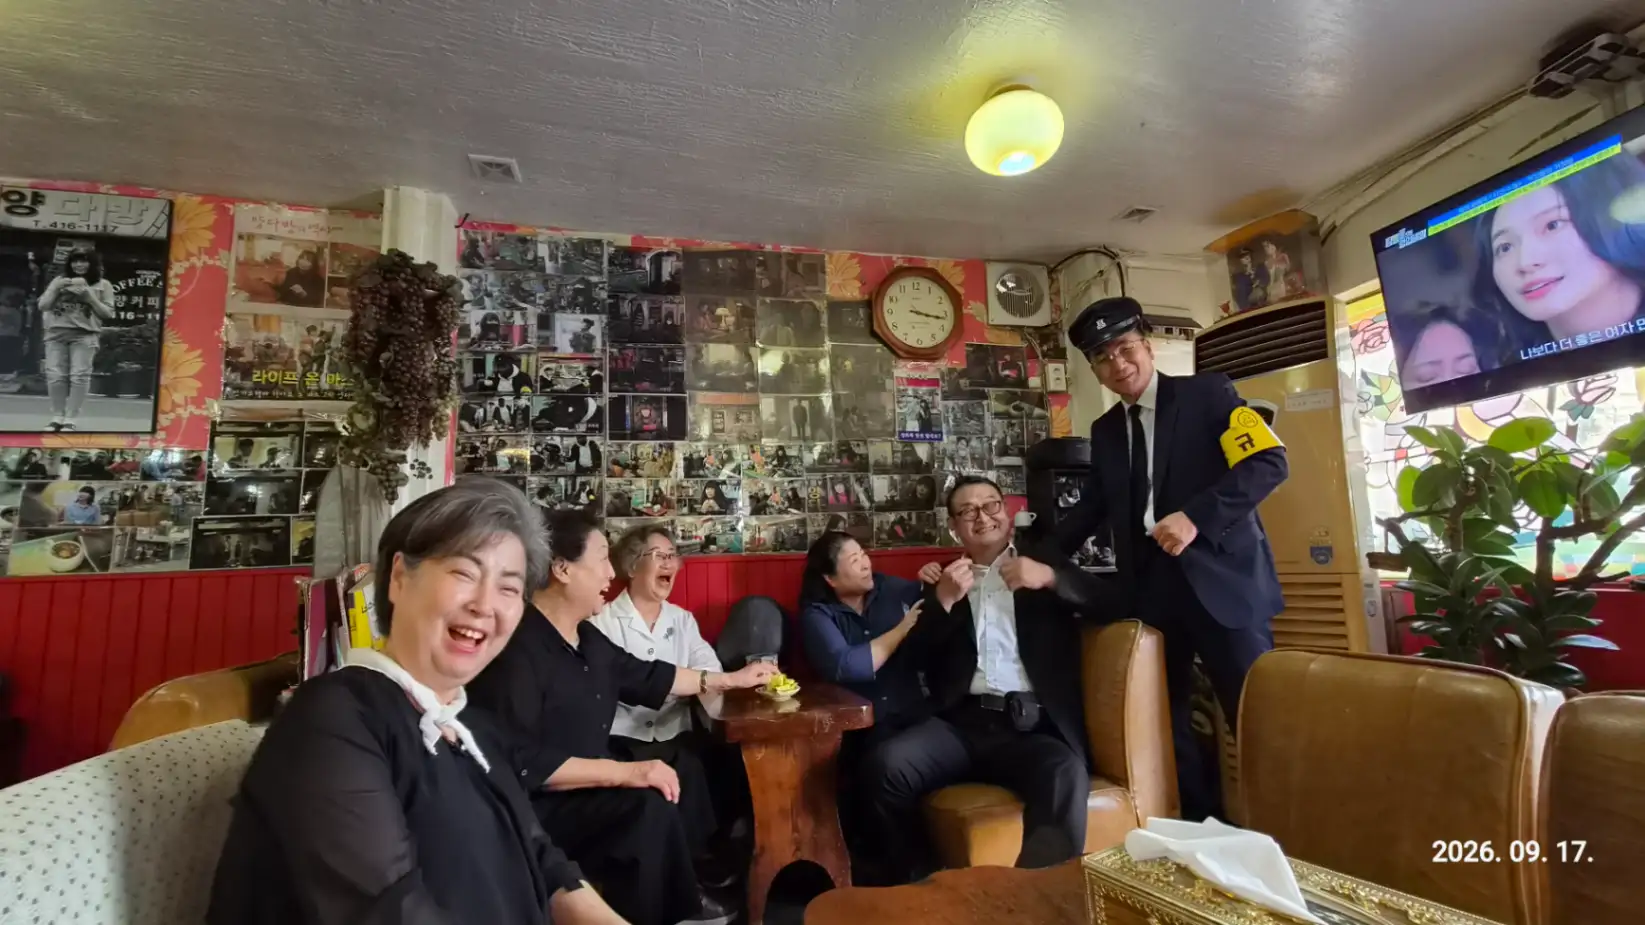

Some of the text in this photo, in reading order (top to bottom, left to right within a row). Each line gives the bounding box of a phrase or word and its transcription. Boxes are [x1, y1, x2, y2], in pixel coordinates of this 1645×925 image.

[112, 277, 154, 294] OFFEE
[899, 284, 906, 294] 11
[912, 282, 920, 291] 12
[928, 283, 933, 294] 1
[888, 295, 898, 304] 10
[937, 296, 943, 304] 2
[891, 321, 898, 331] 8
[938, 324, 945, 332] 4
[902, 332, 909, 341] 7
[930, 333, 936, 341] 5
[1520, 342, 1558, 360] 나보다
[1559, 336, 1573, 351] 더
[1574, 330, 1603, 347] 좋은
[1604, 321, 1635, 339] 여자
[251, 369, 298, 385] 라이프
[304, 371, 321, 386] 온
[1234, 432, 1256, 452] 규
